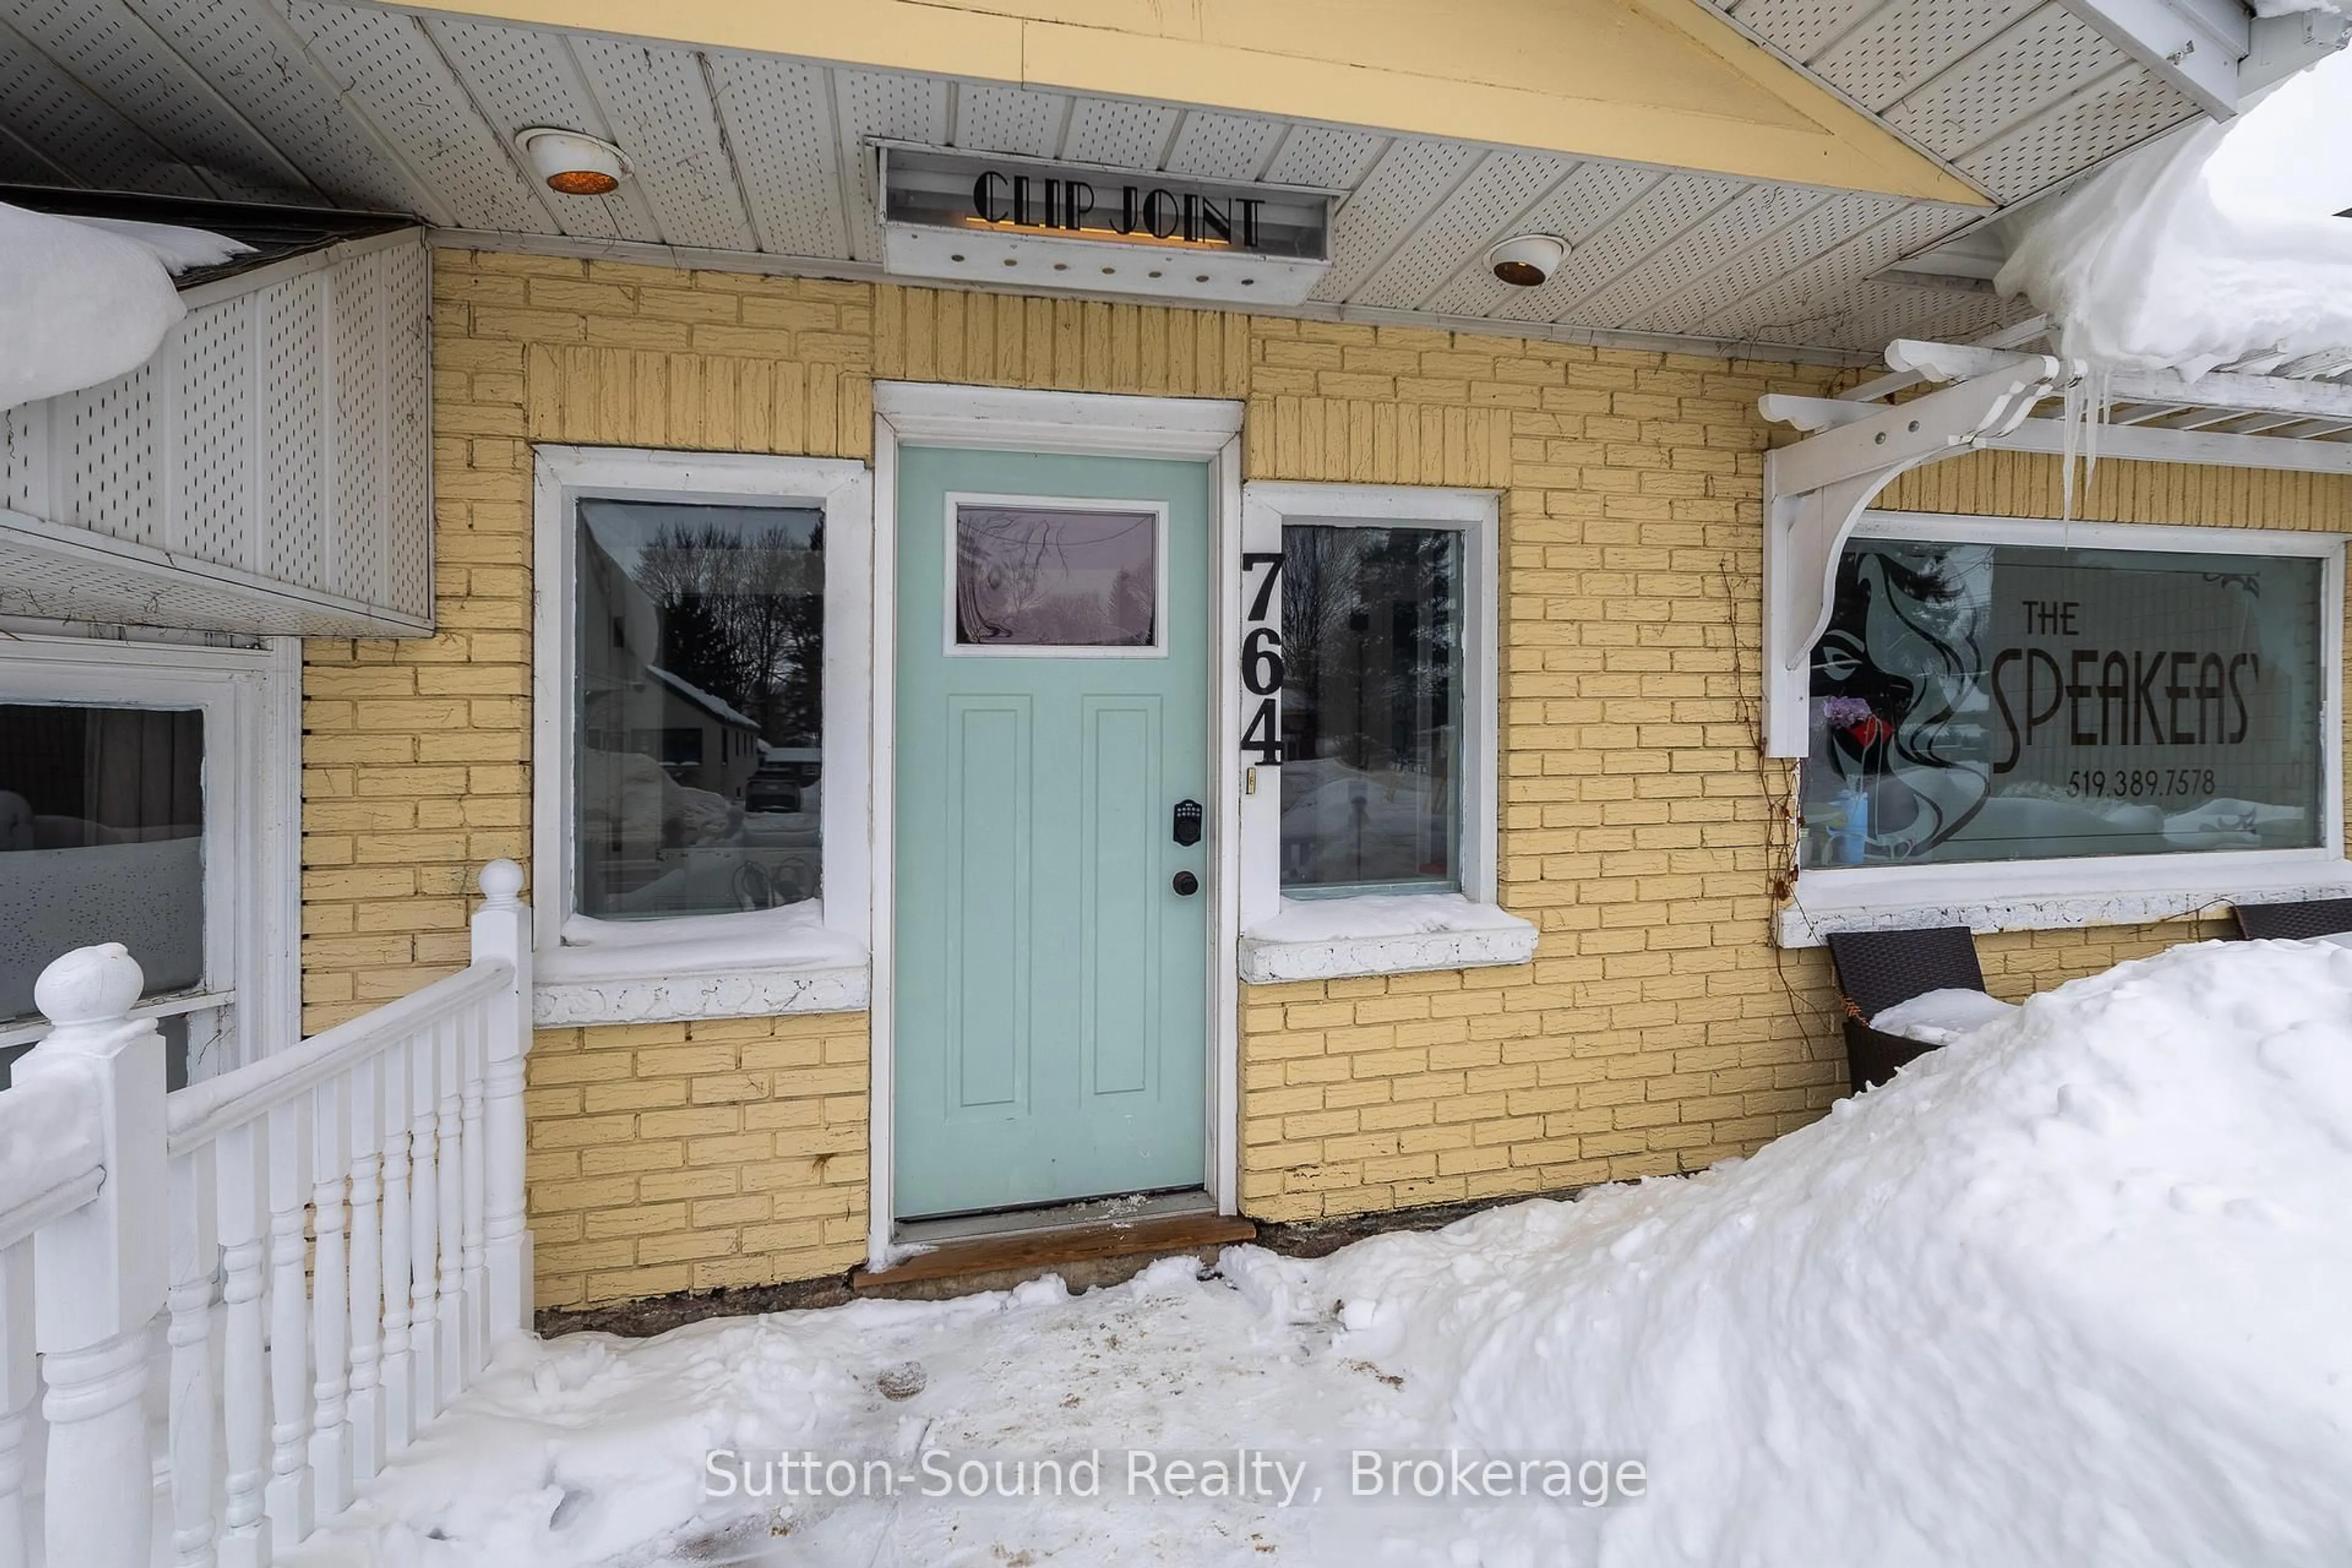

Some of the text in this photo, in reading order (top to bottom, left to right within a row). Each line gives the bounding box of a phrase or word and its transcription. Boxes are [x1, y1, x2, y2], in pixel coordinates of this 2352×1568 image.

[973, 170, 1265, 247] CLIP JOINT
[2022, 600, 2080, 635] THE
[1240, 552, 1286, 766] 764
[1991, 647, 2260, 774] SPEAKEAS
[2065, 769, 2215, 798] 519.389.7578
